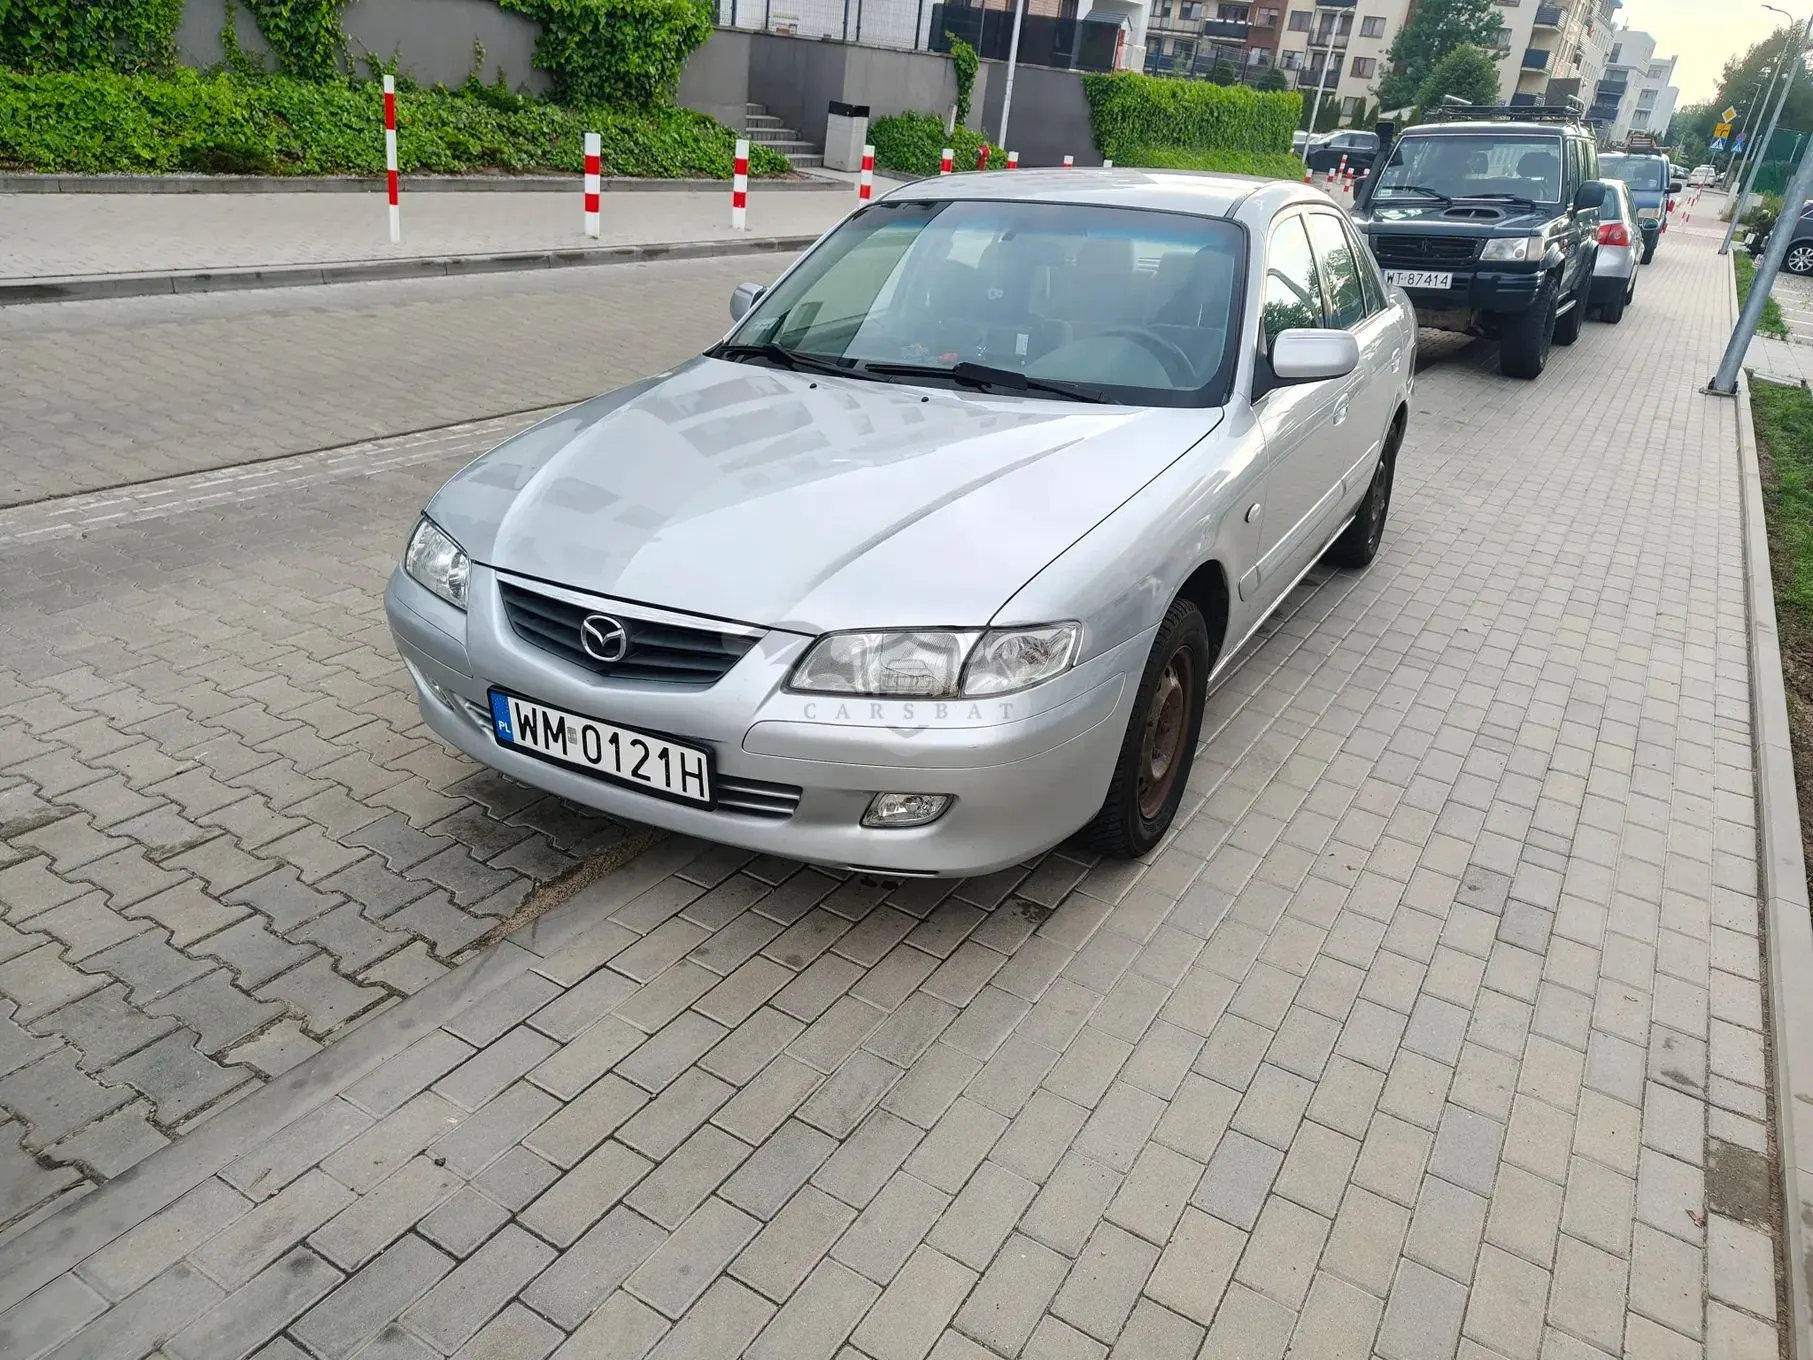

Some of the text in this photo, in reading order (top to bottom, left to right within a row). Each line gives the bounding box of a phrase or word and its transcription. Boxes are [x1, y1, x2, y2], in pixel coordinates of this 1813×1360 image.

[1387, 271, 1449, 287] WT 87414
[498, 720, 512, 734] PL
[515, 702, 705, 798] WM 0121H
